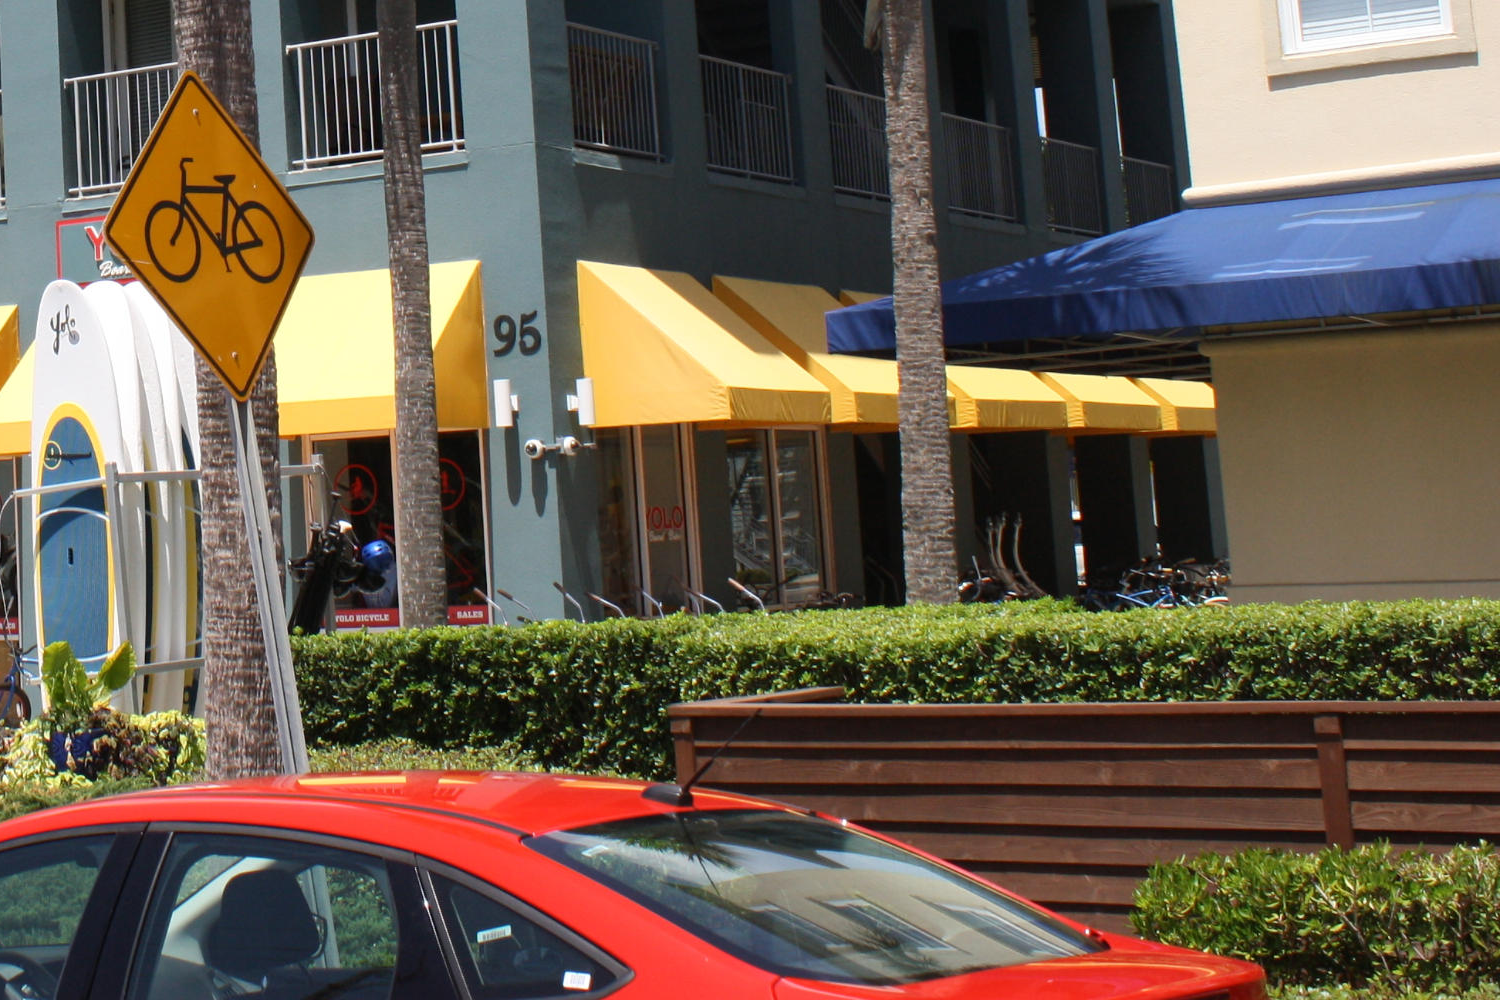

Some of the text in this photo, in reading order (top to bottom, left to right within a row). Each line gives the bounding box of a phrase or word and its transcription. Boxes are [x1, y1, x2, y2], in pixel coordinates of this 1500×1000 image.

[493, 310, 541, 357] 95
[356, 613, 390, 622] BICYCLE
[456, 610, 484, 619] SALES
